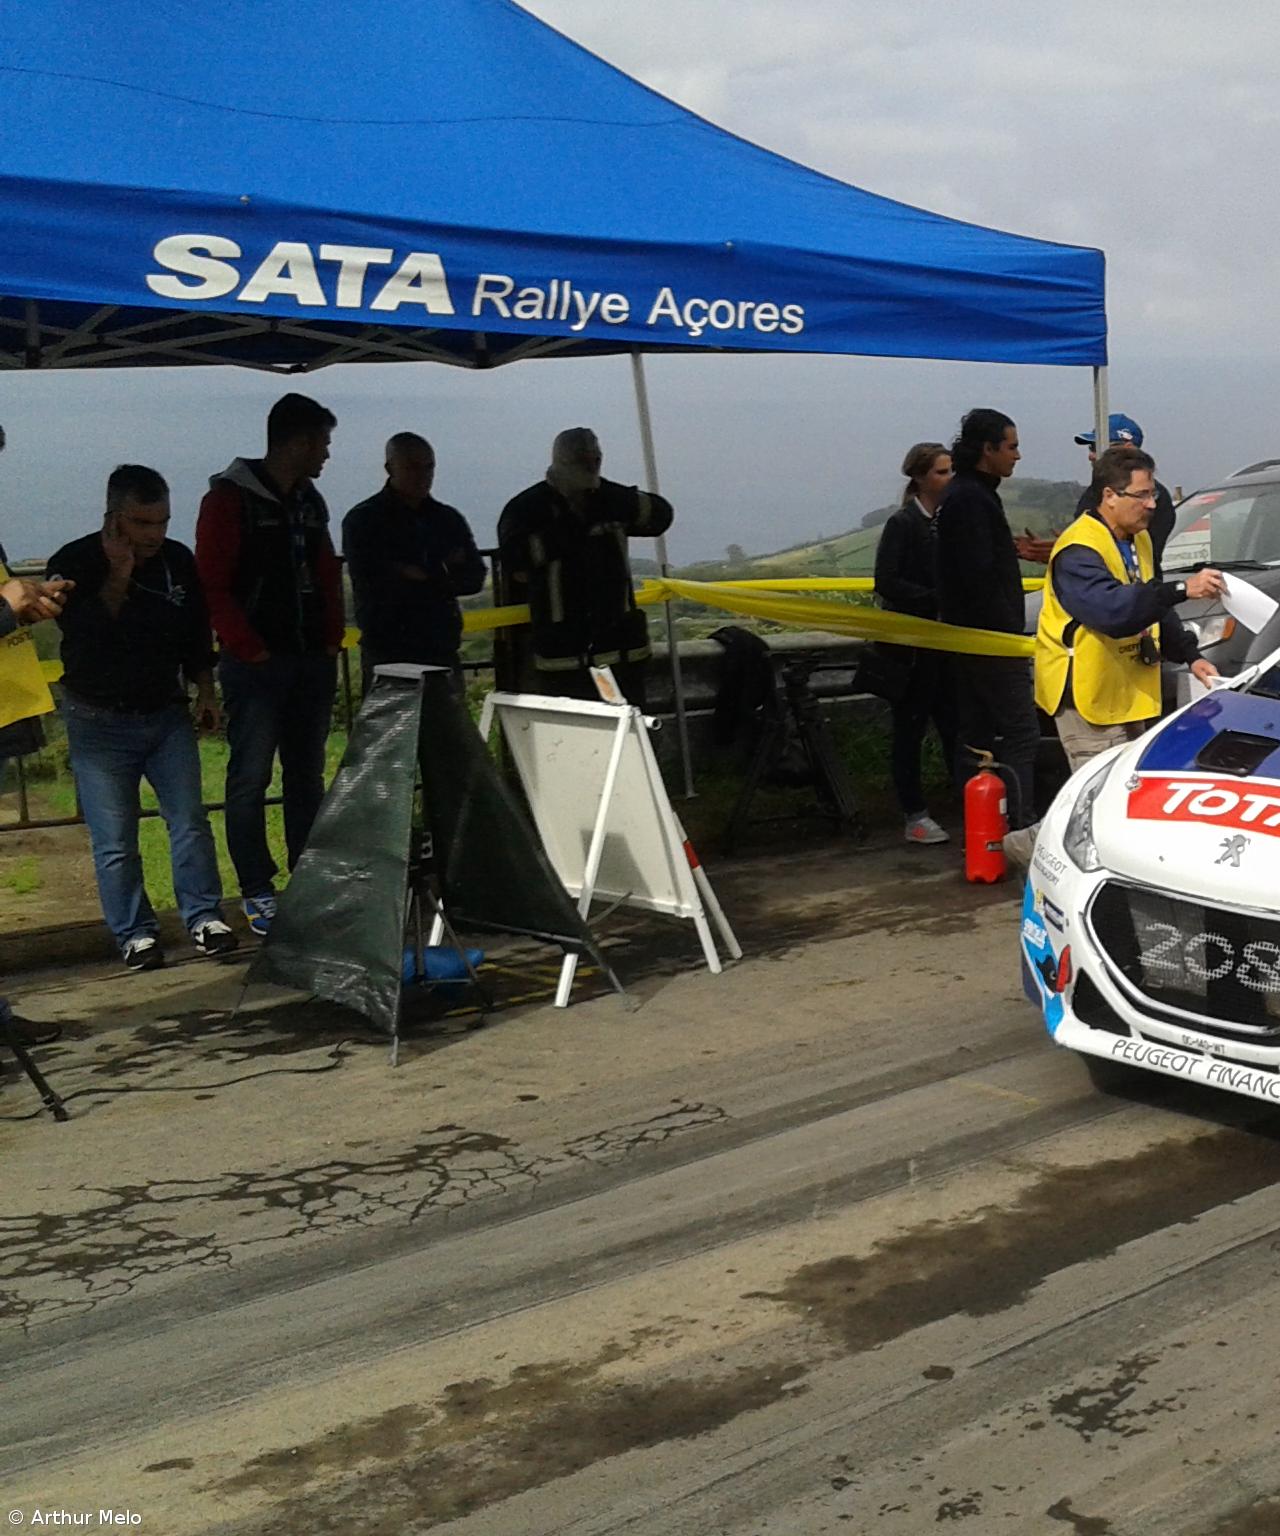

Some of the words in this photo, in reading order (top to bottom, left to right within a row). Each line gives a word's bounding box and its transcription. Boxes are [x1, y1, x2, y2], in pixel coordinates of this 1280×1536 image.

[146, 234, 454, 314] SATA
[472, 274, 630, 331] Rallye
[648, 286, 805, 336] Açores
[1111, 1038, 1203, 1075] PEUGEOT
